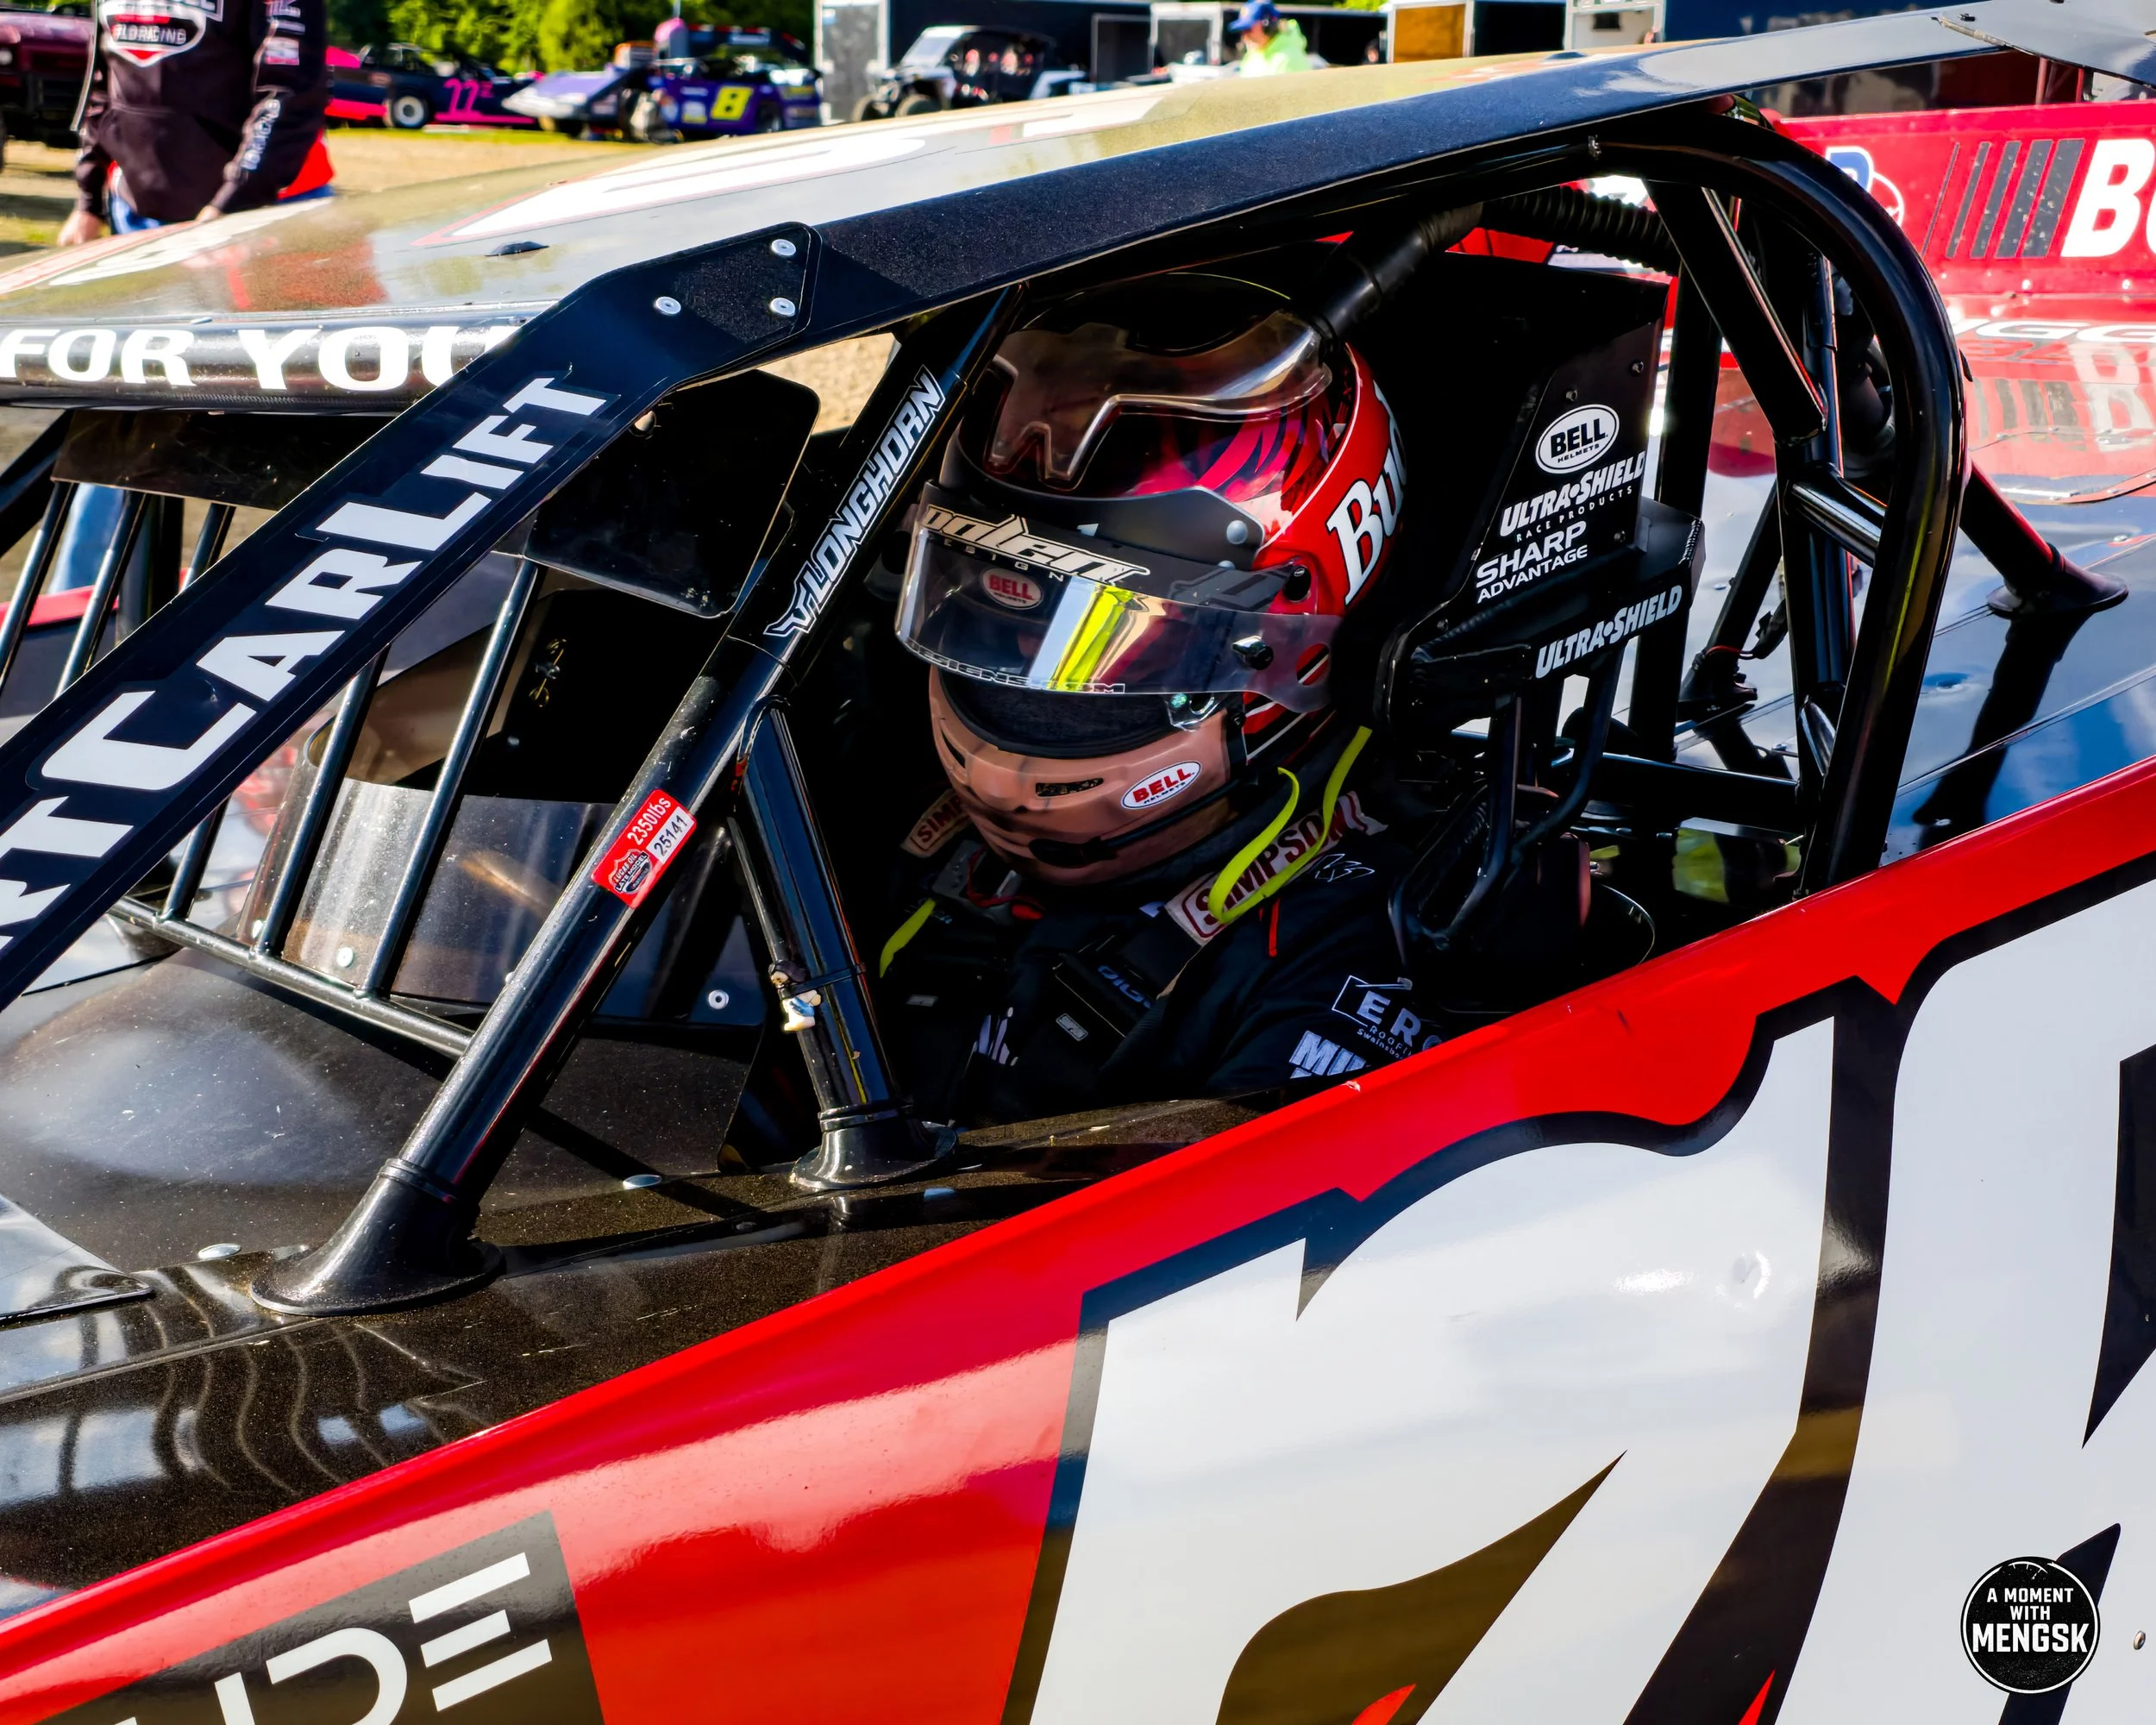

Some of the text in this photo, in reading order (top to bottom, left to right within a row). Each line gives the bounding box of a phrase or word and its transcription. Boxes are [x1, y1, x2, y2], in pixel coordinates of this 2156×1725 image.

[2060, 138, 2156, 258] B
[0, 327, 197, 386] FOR
[1550, 417, 1608, 459] BELL
[1557, 442, 1600, 463] HELMETS
[793, 366, 945, 612] LONGHORN
[1516, 485, 1633, 543] RACE PRODUCTS
[1476, 520, 1587, 588] SHARP
[1476, 544, 1589, 605] ADVANTAGE
[988, 574, 1034, 600] BELL
[1132, 768, 1192, 803] BELL
[627, 797, 671, 846] 2350lbs
[654, 814, 688, 858] 25141
[1357, 1028, 1404, 1060] Swainsbo
